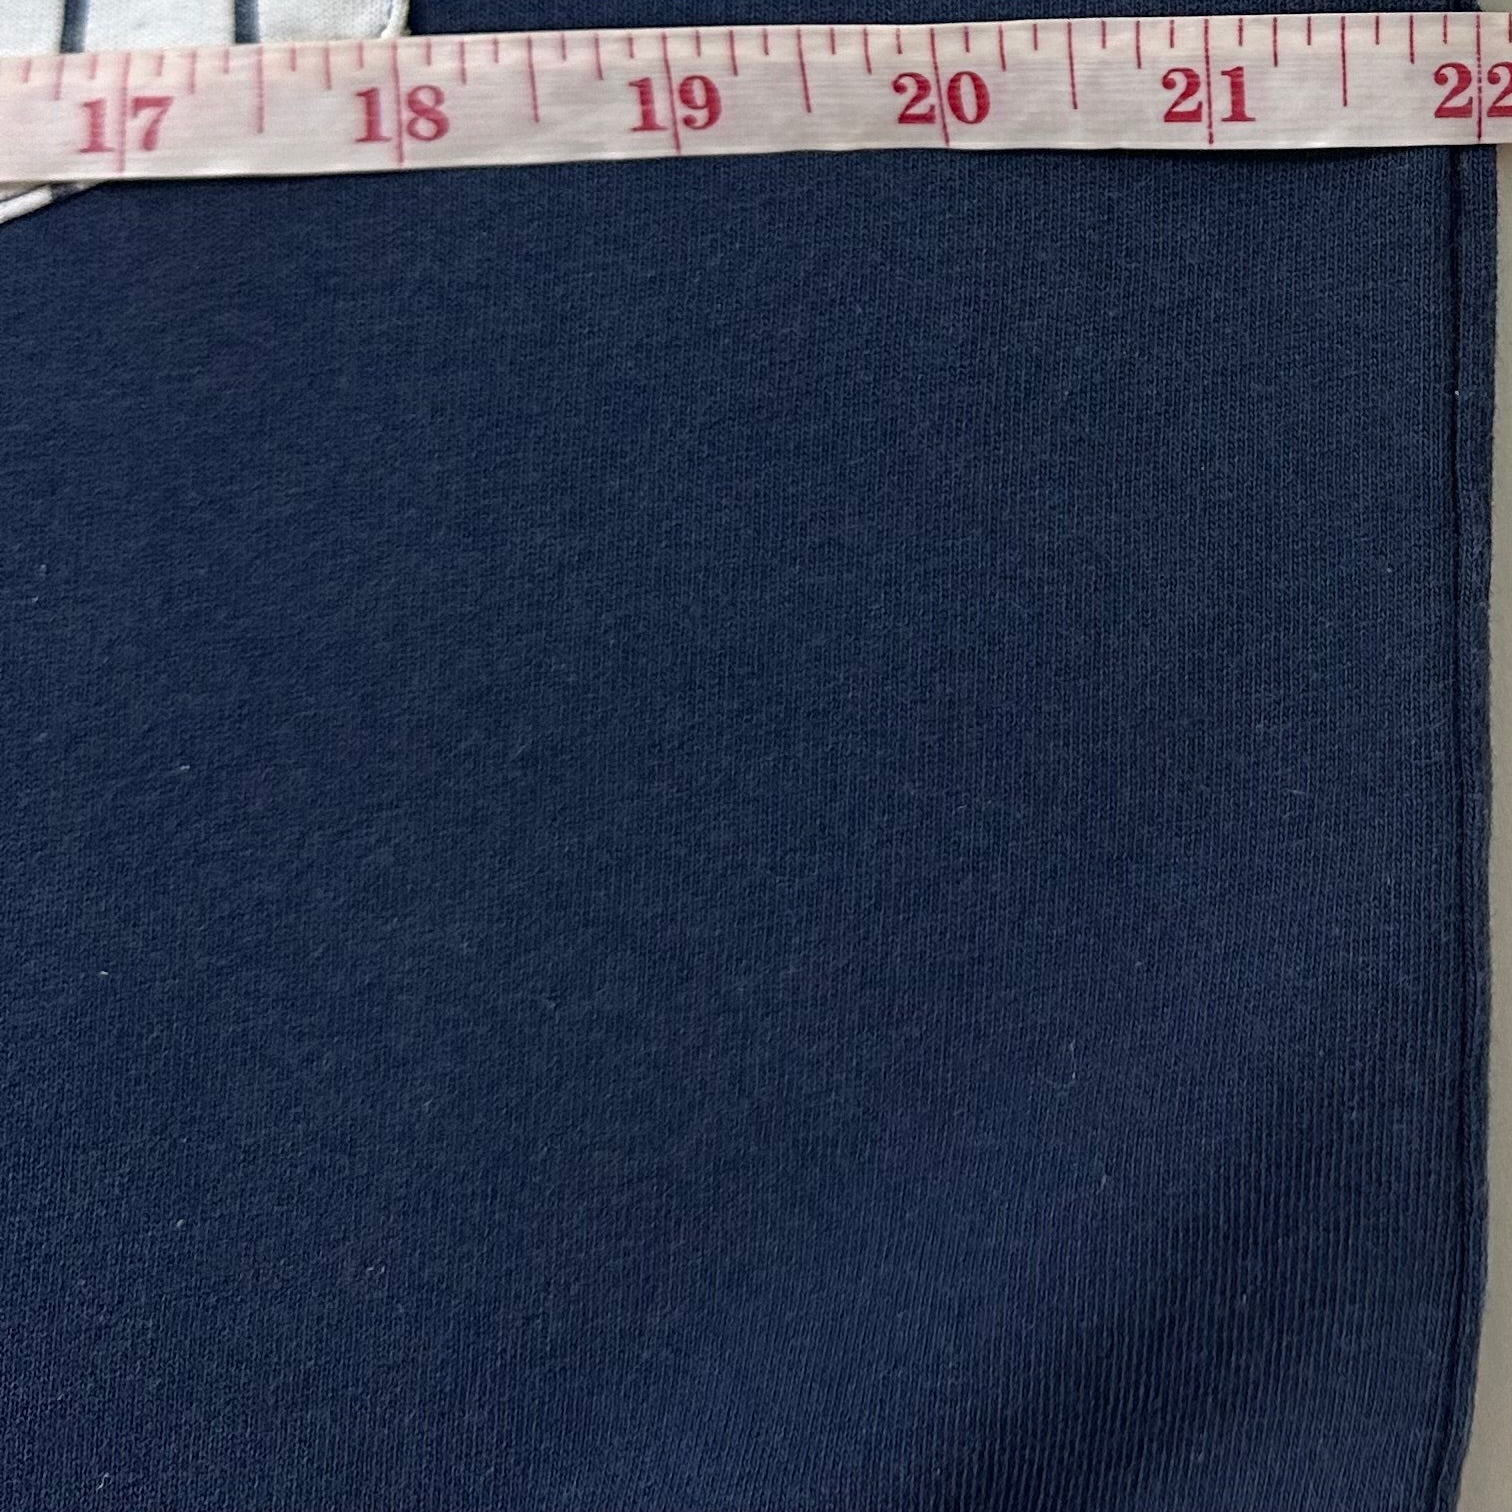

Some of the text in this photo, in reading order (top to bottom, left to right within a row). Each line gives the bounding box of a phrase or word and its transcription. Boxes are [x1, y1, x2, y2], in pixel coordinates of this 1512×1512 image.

[79, 97, 173, 154] 17
[354, 85, 451, 143] 18
[628, 75, 723, 134] 19
[891, 71, 990, 125] 20
[1162, 65, 1256, 123] 21
